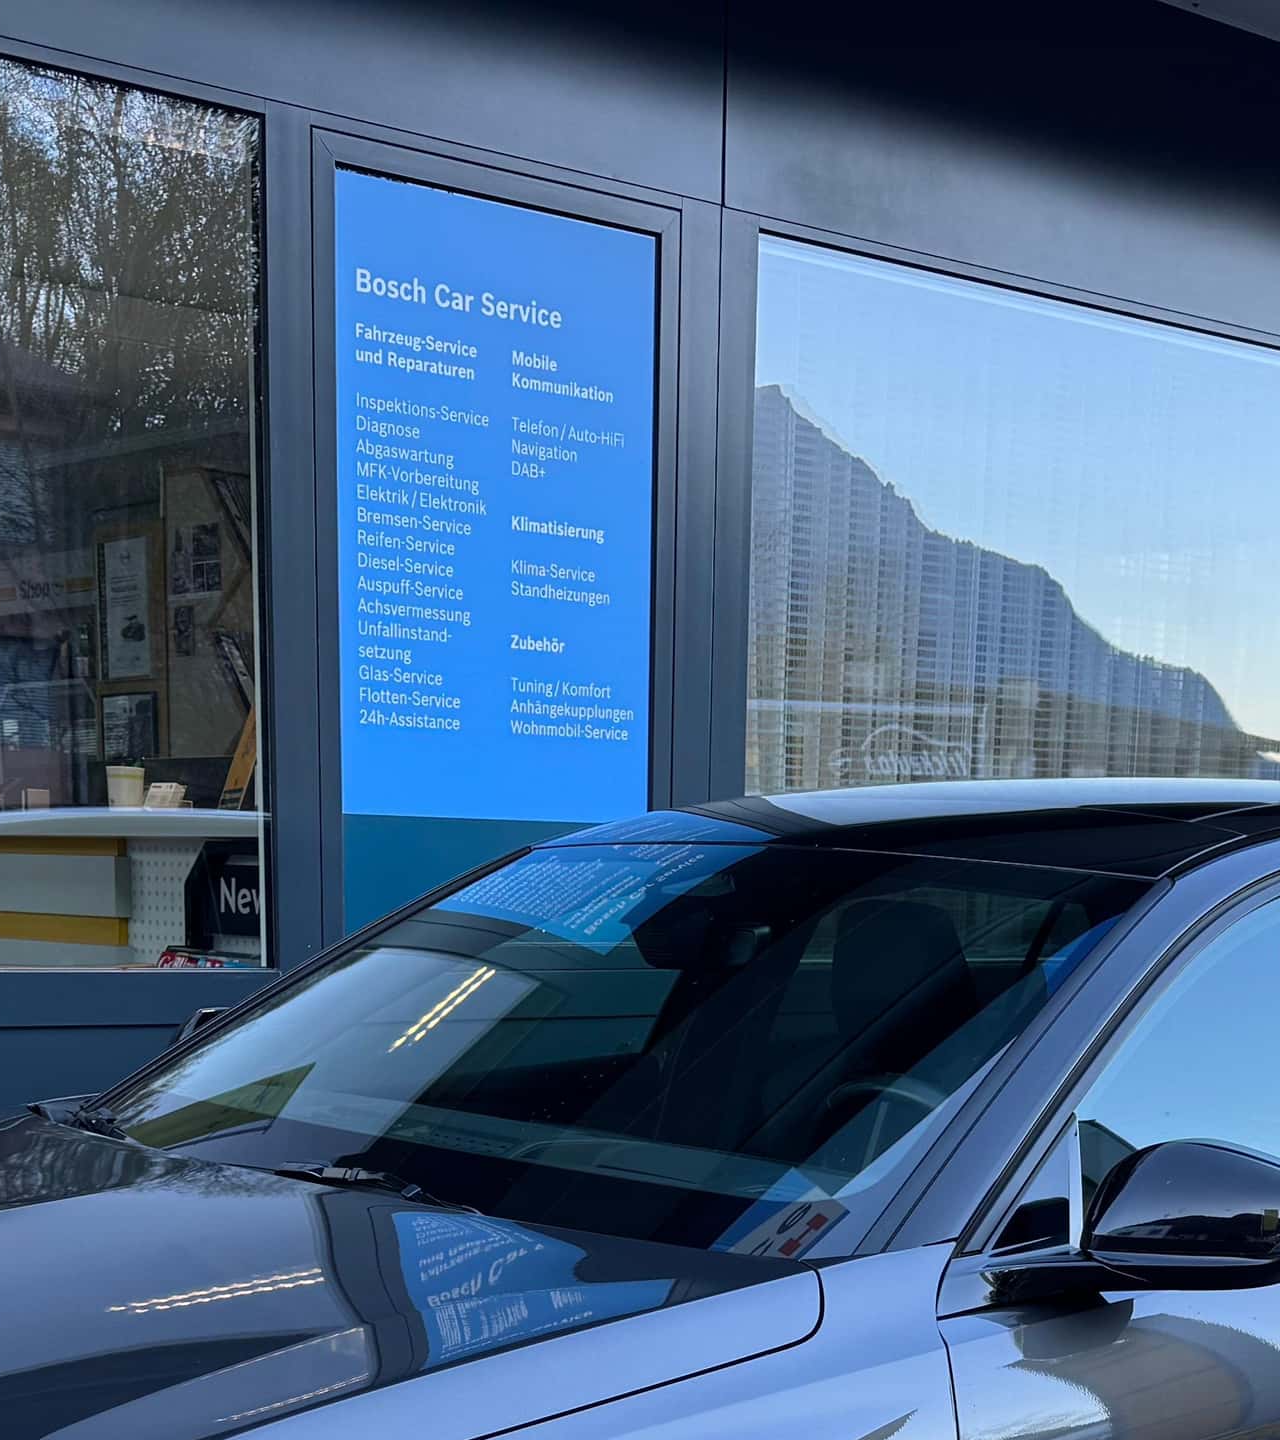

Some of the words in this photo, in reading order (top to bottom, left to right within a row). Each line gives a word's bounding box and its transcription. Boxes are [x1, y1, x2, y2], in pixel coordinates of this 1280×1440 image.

[355, 268, 426, 304] Bosch
[435, 283, 474, 313] Car
[481, 292, 562, 328] Service
[355, 323, 477, 358] Fahrzeug-Service
[355, 349, 382, 366] und
[388, 353, 475, 381] Reparaturen
[511, 350, 558, 372] Mobile
[511, 373, 614, 403] Kommunikation
[356, 393, 489, 427] Inspektions-Service
[356, 416, 420, 440] Diagnose
[356, 440, 454, 470] Abgaswartung
[511, 440, 577, 462] Navigation
[357, 462, 480, 495] MFK-Vorbereitung
[511, 462, 546, 479] DAB+
[357, 485, 409, 505] Elektrik
[420, 493, 487, 515] Elektronik
[357, 507, 472, 536] Bremsen-Service
[511, 516, 605, 544] Klimatisierung
[357, 530, 455, 556] Reifen-Service
[357, 553, 454, 577] Diesel-Service
[511, 559, 595, 583] Klima-Service
[357, 576, 464, 601] Auspuff-Service
[511, 581, 610, 607] Standheizungen
[358, 598, 471, 625] Achsvermessung
[358, 620, 453, 642] Unfallinstand-
[358, 644, 412, 664] setzung
[511, 634, 565, 653] Zubehör
[359, 665, 443, 686] Glas-Service
[511, 677, 553, 697] Tuning
[562, 681, 611, 698] Komfort
[359, 687, 461, 709] Flotten-Service
[359, 709, 461, 731] 24h-Assistance
[511, 699, 634, 722] Anhängekupplungen
[511, 720, 629, 741] Wohnmobil-Service
